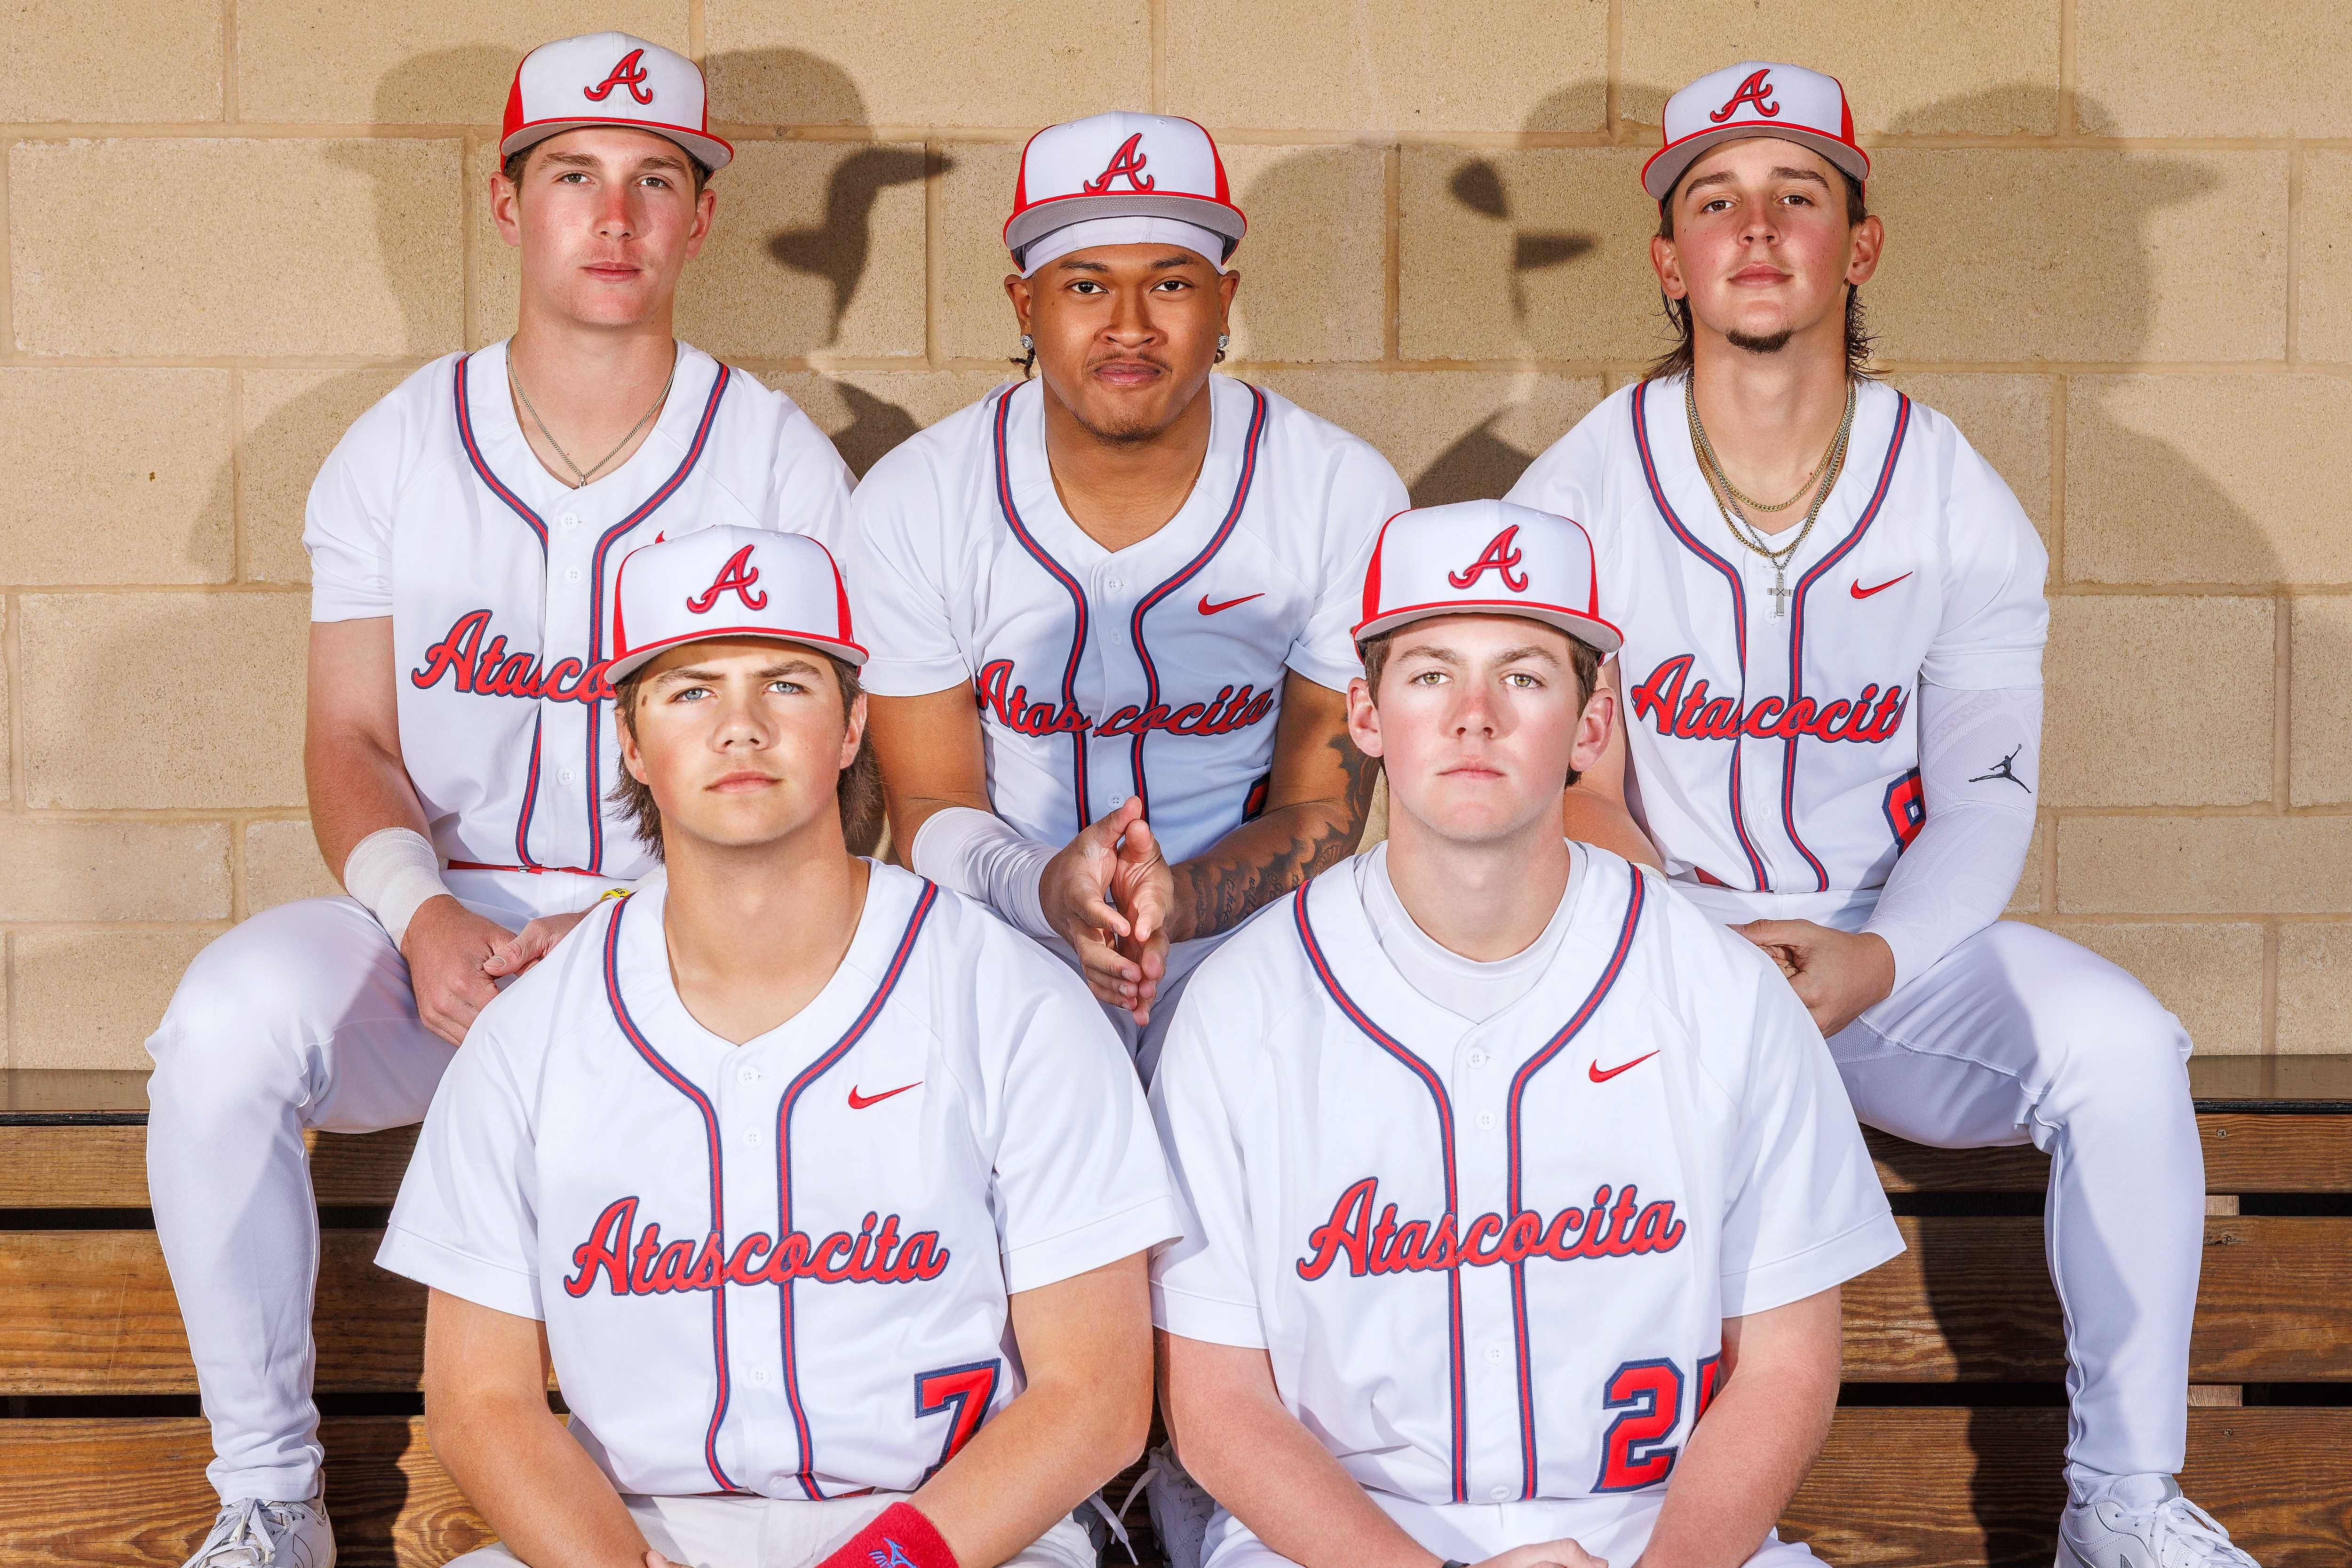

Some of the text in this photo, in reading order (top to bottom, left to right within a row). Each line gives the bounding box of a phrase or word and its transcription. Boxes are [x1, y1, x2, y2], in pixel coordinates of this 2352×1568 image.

[584, 48, 653, 105] A
[1710, 68, 1780, 123] A
[1083, 133, 1155, 192] A
[687, 544, 768, 614] A
[1448, 525, 1528, 592] A
[564, 1195, 950, 1298] Atascocita
[1296, 1176, 1686, 1281] Atascocita
[914, 1357, 1001, 1493] 7
[1589, 1353, 1721, 1494] 2
